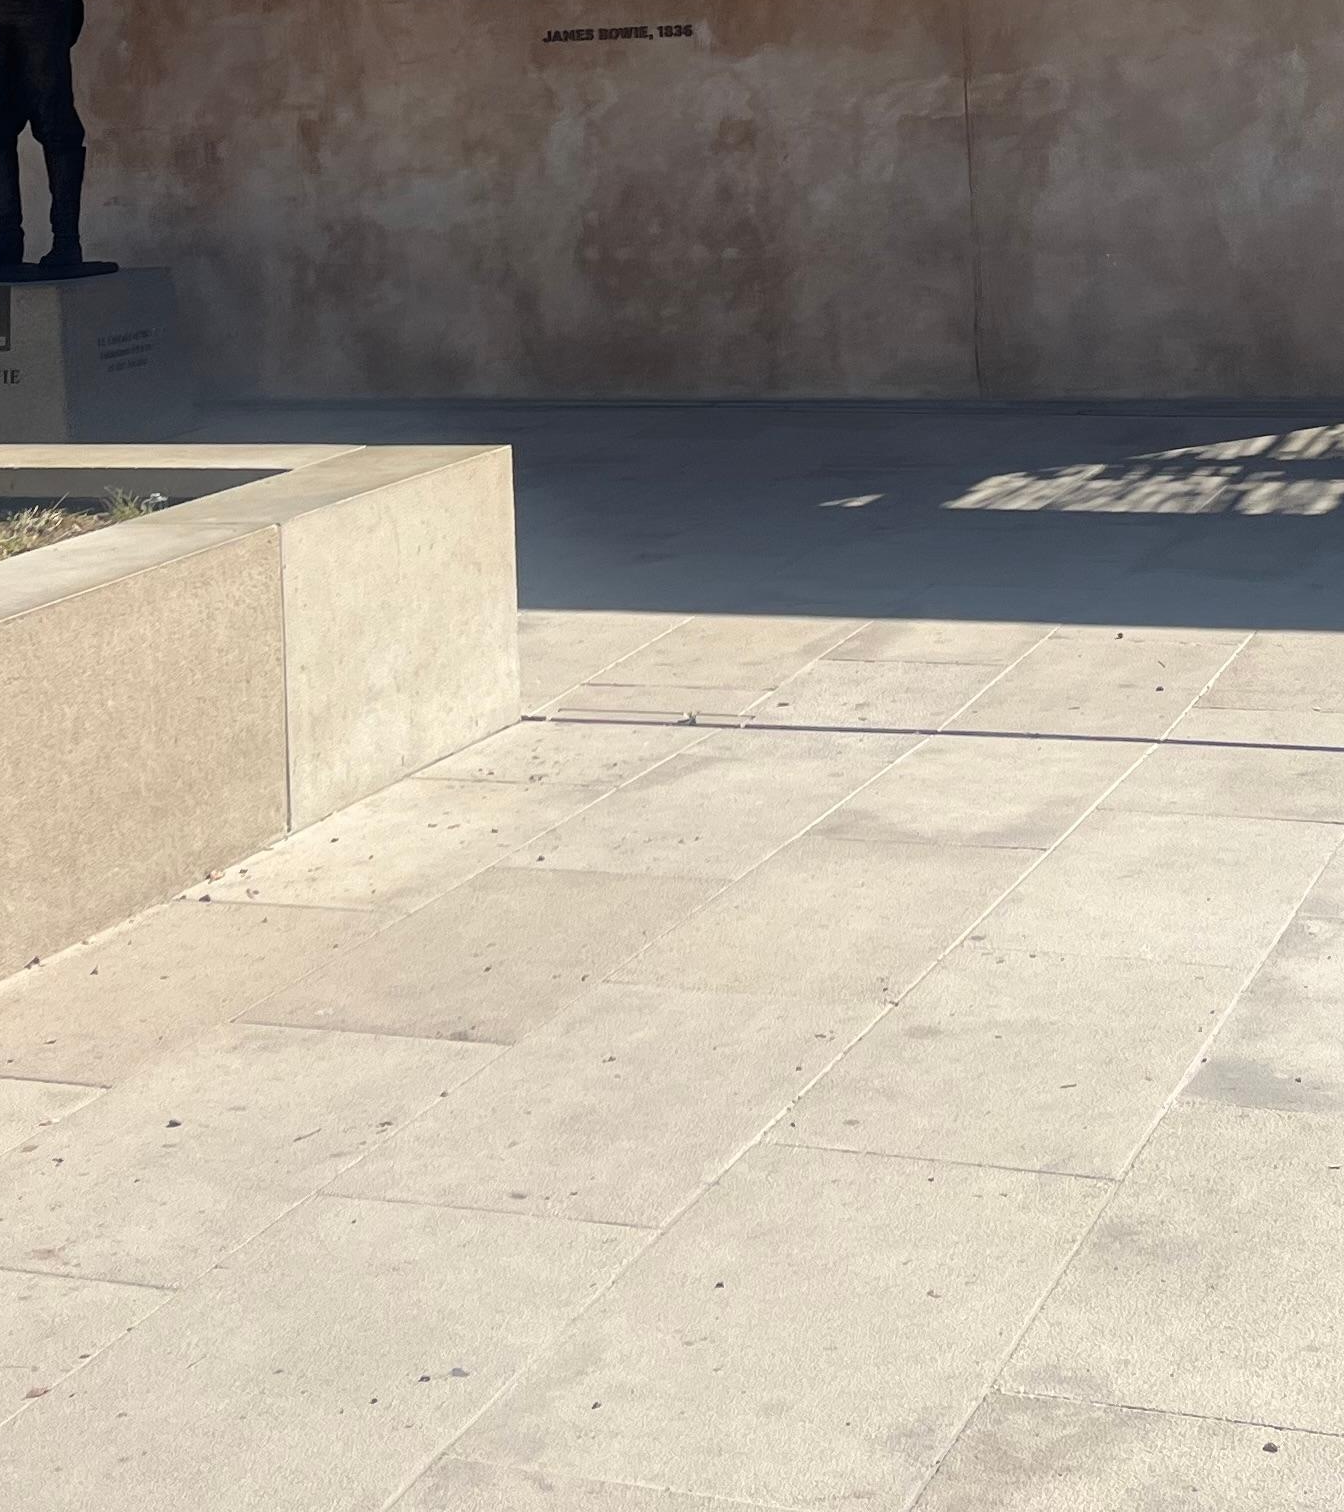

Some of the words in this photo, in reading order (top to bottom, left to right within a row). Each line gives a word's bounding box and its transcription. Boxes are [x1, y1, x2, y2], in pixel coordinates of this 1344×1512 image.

[542, 29, 595, 43] JAMES
[598, 26, 653, 40] BOWIE,
[657, 24, 693, 38] 1836
